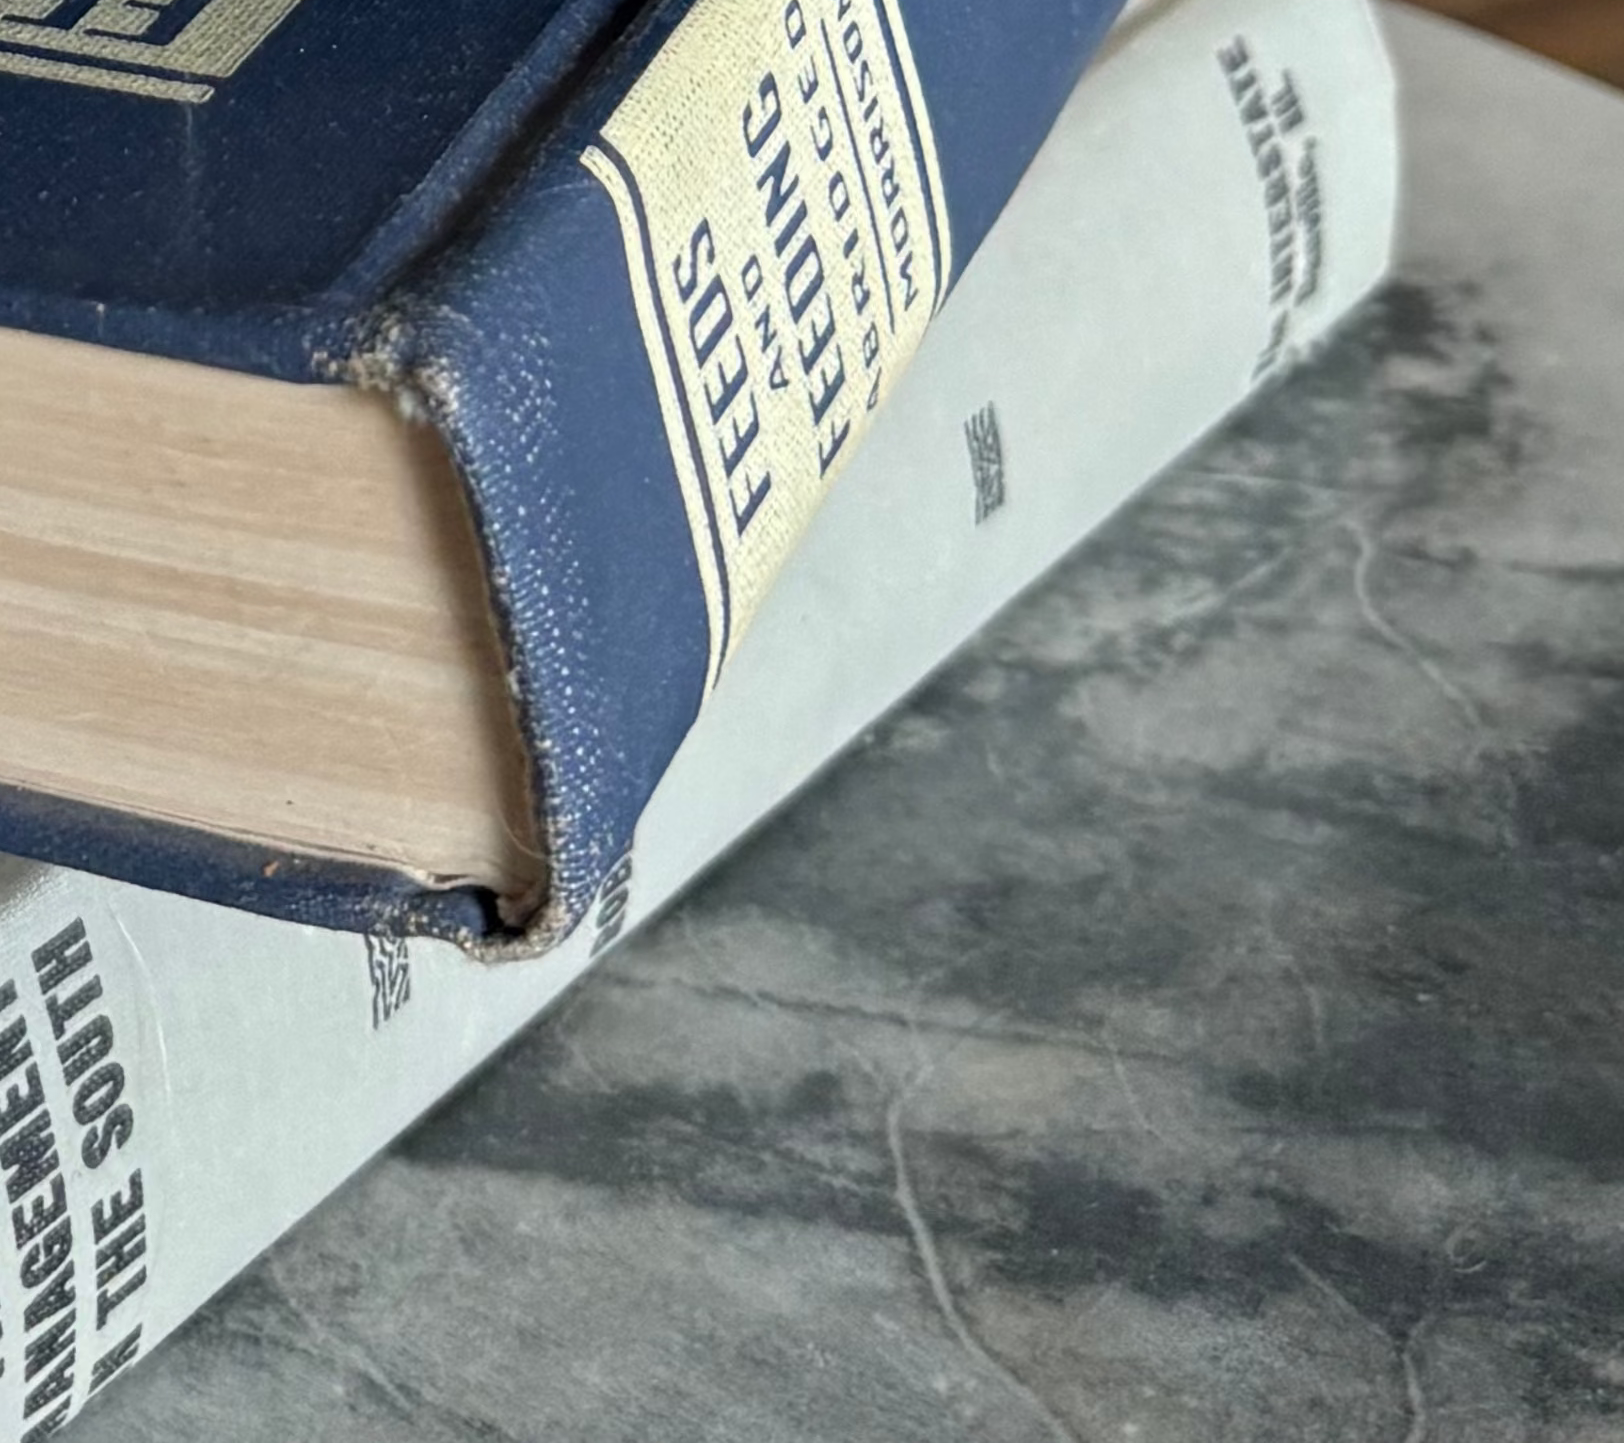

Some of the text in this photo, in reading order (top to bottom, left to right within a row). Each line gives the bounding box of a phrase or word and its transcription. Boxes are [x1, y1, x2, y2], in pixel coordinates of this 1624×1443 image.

[673, 217, 771, 537] FEEDS
[741, 254, 789, 391] AND
[742, 71, 851, 480] FEEDING
[31, 917, 134, 1169] SOUTH
[92, 1168, 147, 1331] THE
